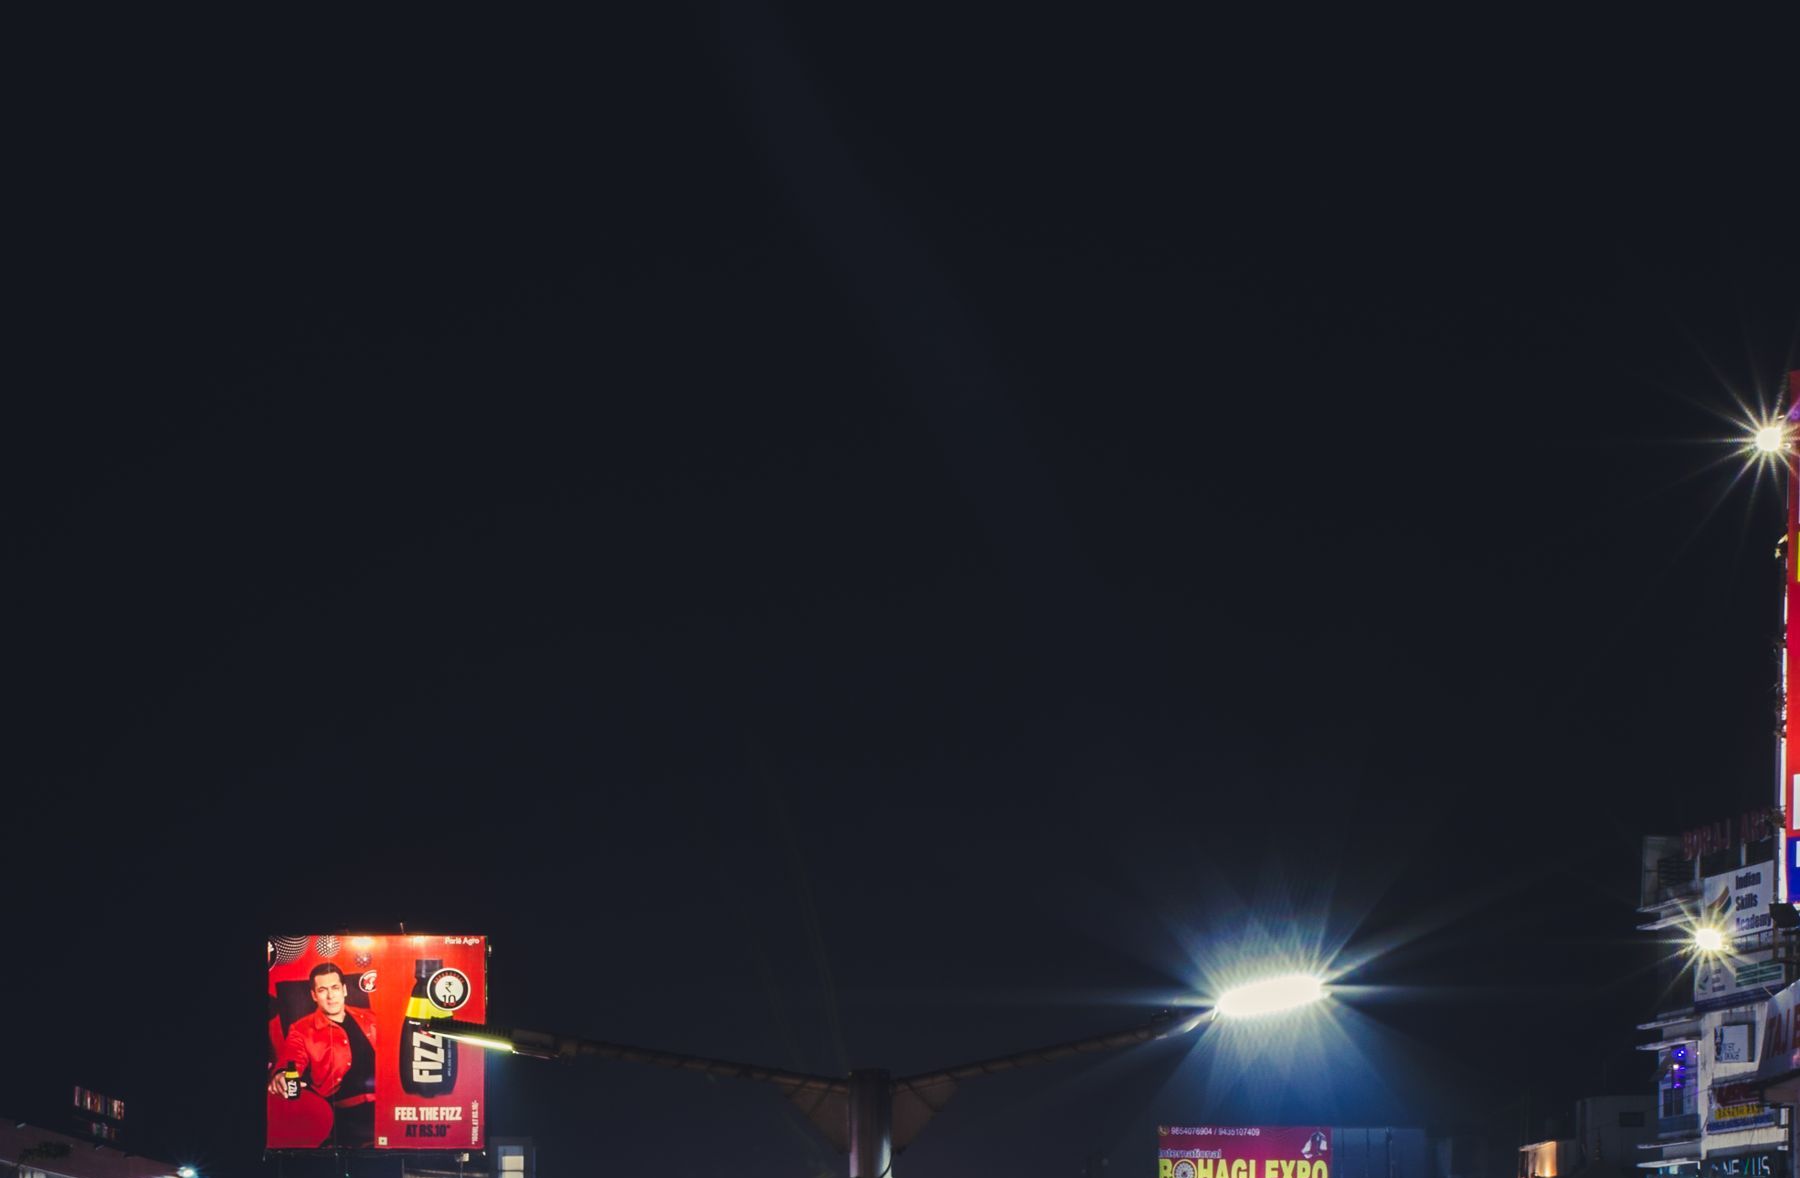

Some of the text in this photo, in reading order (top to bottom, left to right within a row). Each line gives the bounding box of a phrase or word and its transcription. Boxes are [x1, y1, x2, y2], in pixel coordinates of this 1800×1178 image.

[1735, 872, 1762, 890] Indian
[1735, 893, 1759, 912] Skills
[412, 1030, 445, 1083] FIZZ
[394, 1106, 462, 1121] FEEL THE FIZZ
[405, 1125, 417, 1137] AT
